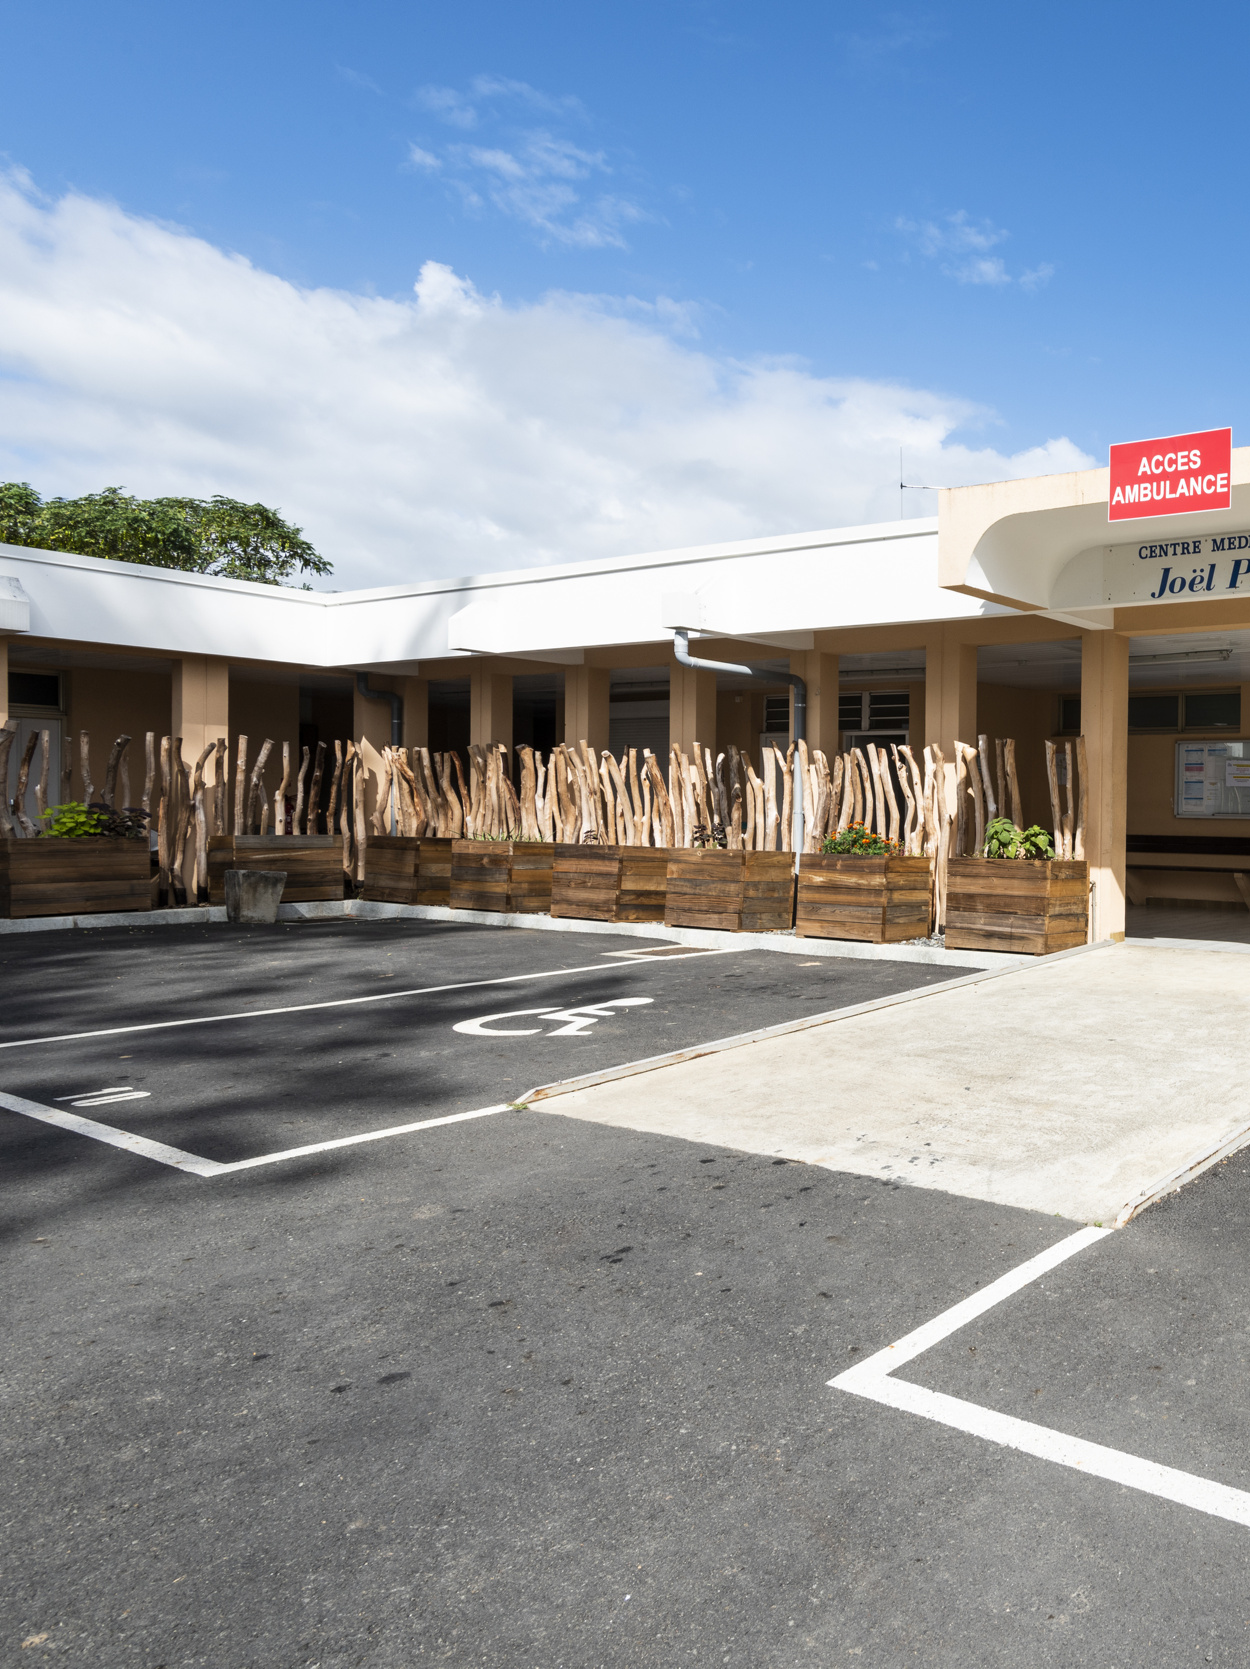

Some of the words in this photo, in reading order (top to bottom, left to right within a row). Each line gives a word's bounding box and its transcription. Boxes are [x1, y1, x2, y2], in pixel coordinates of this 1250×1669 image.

[1137, 449, 1202, 477] ACCES
[1111, 472, 1229, 506] AMBULANCE
[1138, 540, 1202, 560] CENTRE
[1150, 563, 1217, 599] Joël
